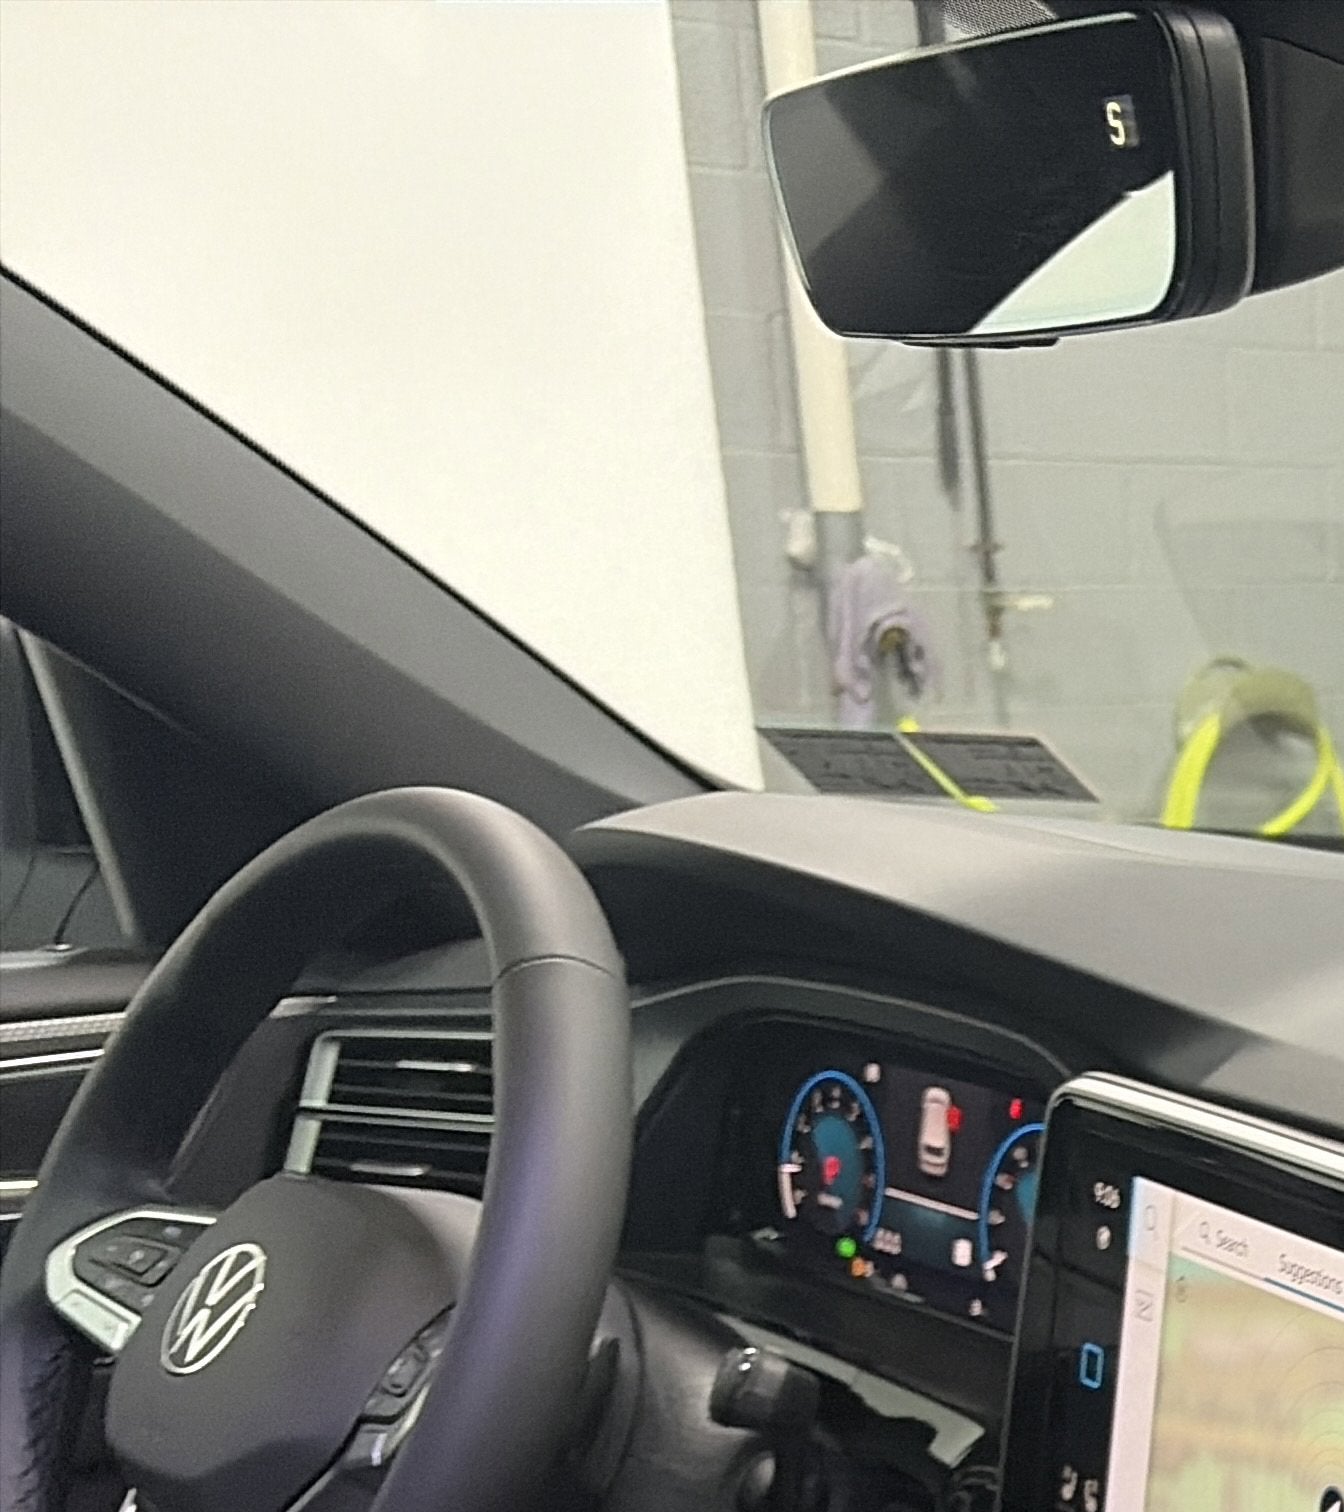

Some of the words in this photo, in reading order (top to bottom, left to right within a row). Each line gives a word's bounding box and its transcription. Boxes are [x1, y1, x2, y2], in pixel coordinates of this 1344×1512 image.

[1106, 101, 1125, 146] S
[1215, 1229, 1249, 1257] Search
[1278, 1253, 1343, 1295] Suggestions
